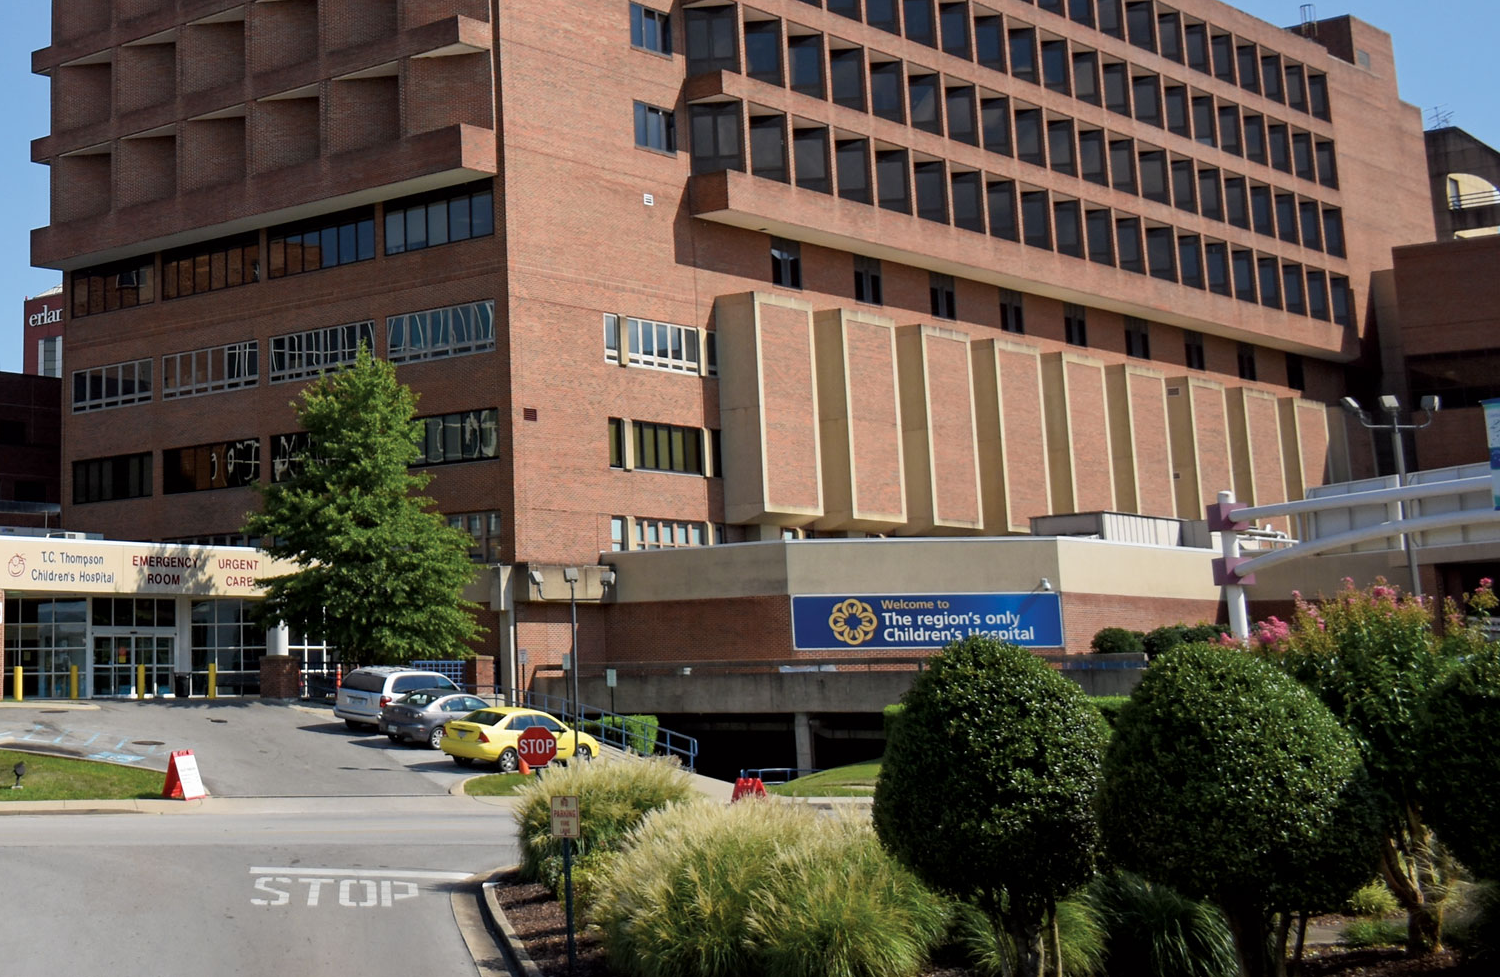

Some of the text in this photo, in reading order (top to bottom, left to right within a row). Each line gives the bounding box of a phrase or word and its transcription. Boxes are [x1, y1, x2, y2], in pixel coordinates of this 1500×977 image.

[41, 550, 104, 567] T.C. Thompson
[132, 555, 198, 569] EMERGENCY
[218, 559, 259, 571] URGENT
[31, 568, 76, 582] Children's
[147, 573, 180, 586] ROOM
[226, 575, 254, 587] CARE
[880, 599, 950, 609] Welcome to
[882, 610, 1021, 629] The region's only
[883, 627, 962, 641] Children's
[519, 738, 555, 755] STOP
[554, 809, 576, 818] PARKING
[249, 876, 420, 907] STOP
